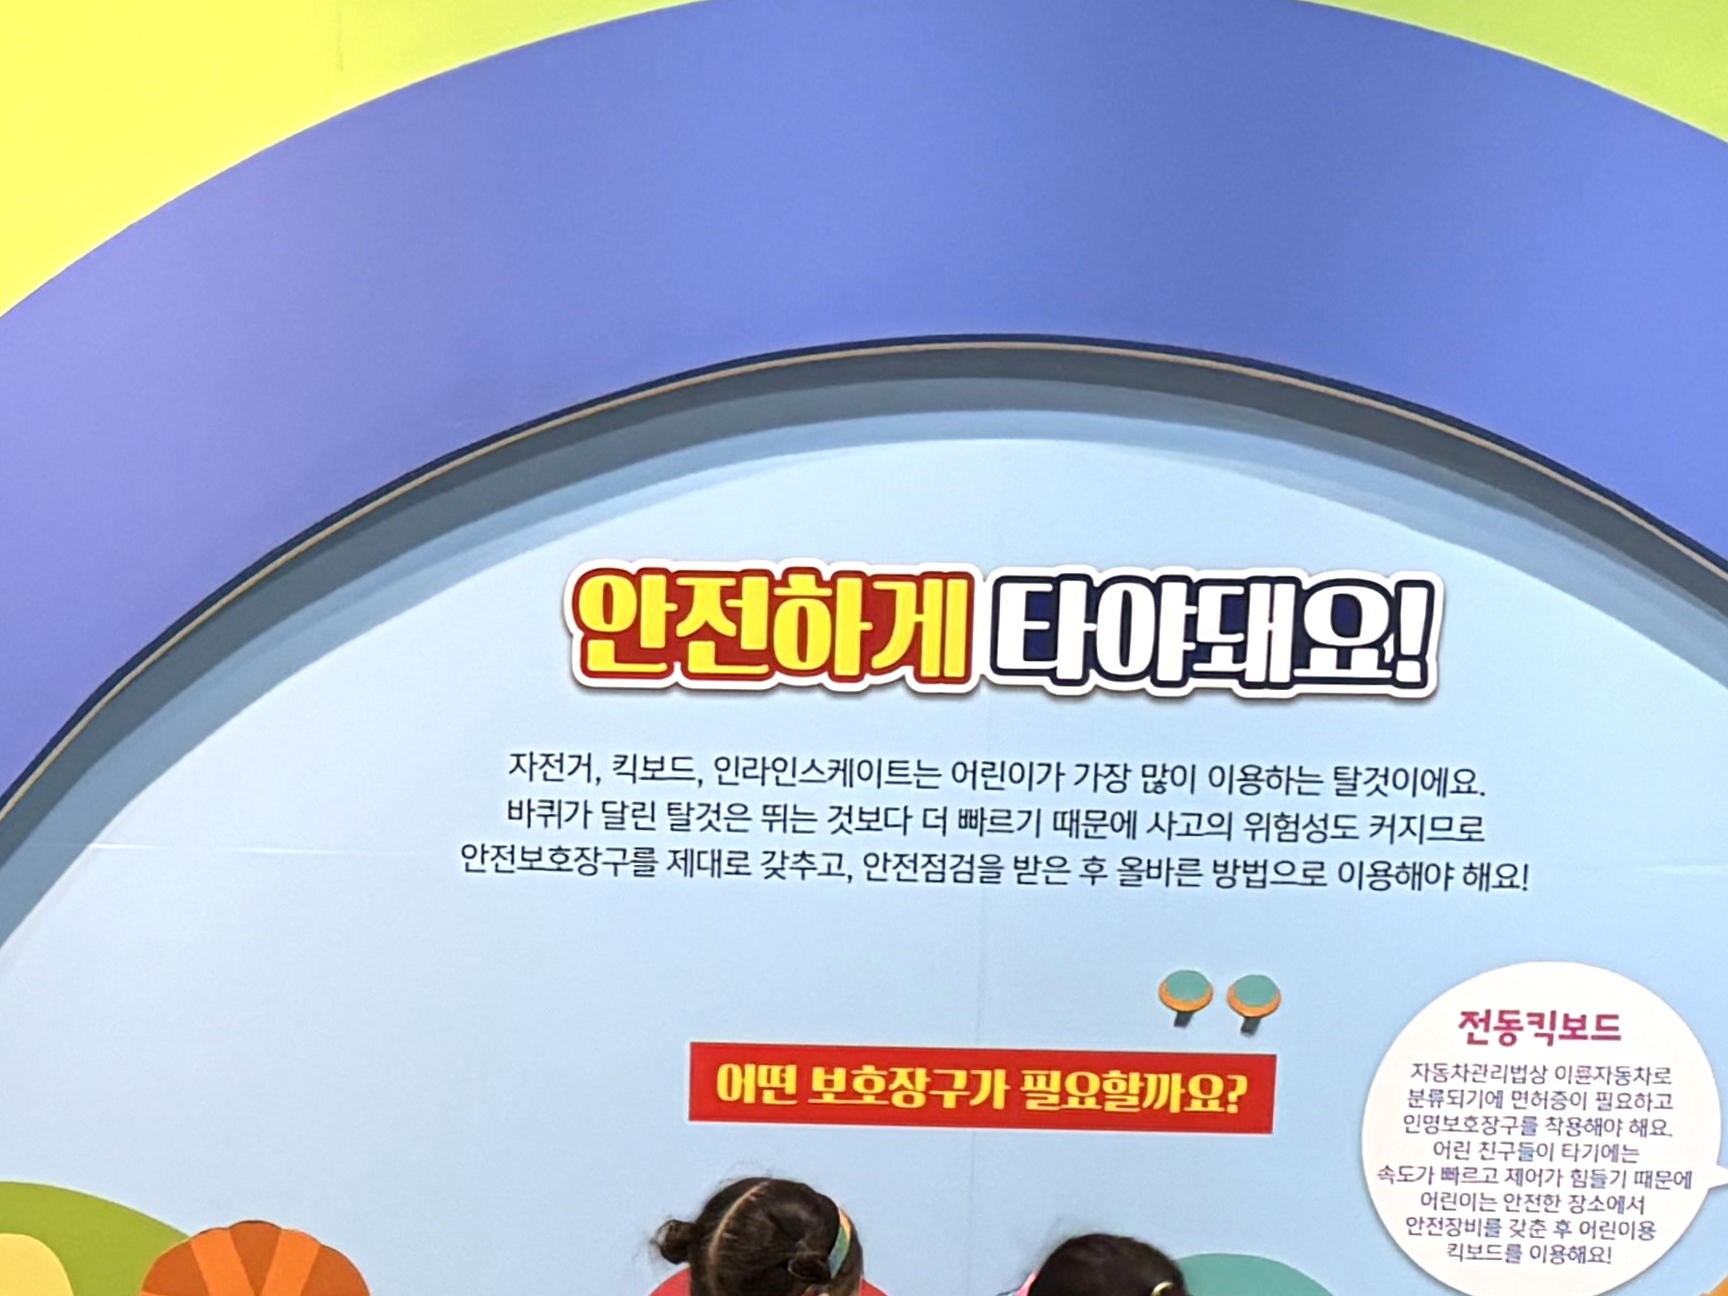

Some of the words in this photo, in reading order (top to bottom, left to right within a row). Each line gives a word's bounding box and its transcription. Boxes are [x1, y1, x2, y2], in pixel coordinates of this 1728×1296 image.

[577, 571, 969, 680] 안전하게
[997, 574, 1433, 685] 타야돼요!
[509, 751, 601, 786] 자전거,
[613, 753, 703, 788] 킥보드,
[714, 755, 942, 790] 인라인스케이트는
[952, 760, 1065, 792] 어린이가
[1074, 762, 1132, 793] 가장
[1141, 763, 1196, 795] 많이
[1208, 764, 1324, 796] 이용하는
[1334, 766, 1486, 798] 탈것이에요.
[507, 798, 593, 831] 바퀴가
[602, 800, 657, 832] 달린
[667, 801, 752, 833] 탈것은
[761, 803, 819, 835] 뛰는
[827, 804, 913, 836] 것보다
[922, 806, 949, 838] 더
[958, 807, 1042, 839] 빠르기
[1053, 809, 1138, 841] 때문에
[1146, 810, 1233, 842] 사고의
[1243, 811, 1361, 844] 위험성도
[1369, 814, 1486, 846] 커지므로
[460, 843, 659, 878] 안전보호장구를
[666, 847, 753, 879] 제대로
[760, 848, 853, 884] 갖추고,
[863, 852, 1005, 885] 안전점검을
[1013, 855, 1071, 886] 받은
[1079, 855, 1109, 887] 후
[1116, 857, 1204, 889] 올바른
[1213, 858, 1328, 890] 방법으로
[1337, 860, 1455, 892] 이용해야
[1462, 861, 1530, 892] 해요!
[1457, 1008, 1622, 1047] 전동킥보드
[1410, 1062, 1548, 1085] 자동차관리법상
[1554, 1064, 1673, 1086] 이륜자동차로
[716, 1063, 797, 1104] 어떤
[807, 1065, 1010, 1110] 보호장구가
[1019, 1069, 1249, 1114] 필요할까요?
[1407, 1088, 1503, 1109] 분류되기에
[1511, 1089, 1588, 1111] 면허증이
[1595, 1091, 1674, 1112] 필요하고
[1403, 1114, 1538, 1136] 인명보호장구를
[1544, 1115, 1623, 1138] 착용해야
[1628, 1117, 1673, 1138] 해요.
[1433, 1140, 1471, 1161] 어린
[1477, 1141, 1554, 1163] 친구들이
[1561, 1142, 1640, 1164] 타기에는
[1376, 1164, 1435, 1186] 속도가
[1440, 1165, 1500, 1186] 빠르고
[1504, 1167, 1564, 1188] 제어가
[1570, 1168, 1627, 1190] 힘들기
[1634, 1169, 1693, 1191] 때문에
[1420, 1191, 1498, 1213] 어린이는
[1502, 1192, 1562, 1214] 안전한
[1567, 1194, 1645, 1216] 장소에서
[1405, 1216, 1503, 1239] 안전장비를
[1509, 1218, 1548, 1240] 갖춘
[1552, 1219, 1573, 1240] 후
[1579, 1220, 1657, 1242] 어린이용
[1446, 1243, 1523, 1264] 킥보드를
[1529, 1244, 1612, 1265] 이용해요!
